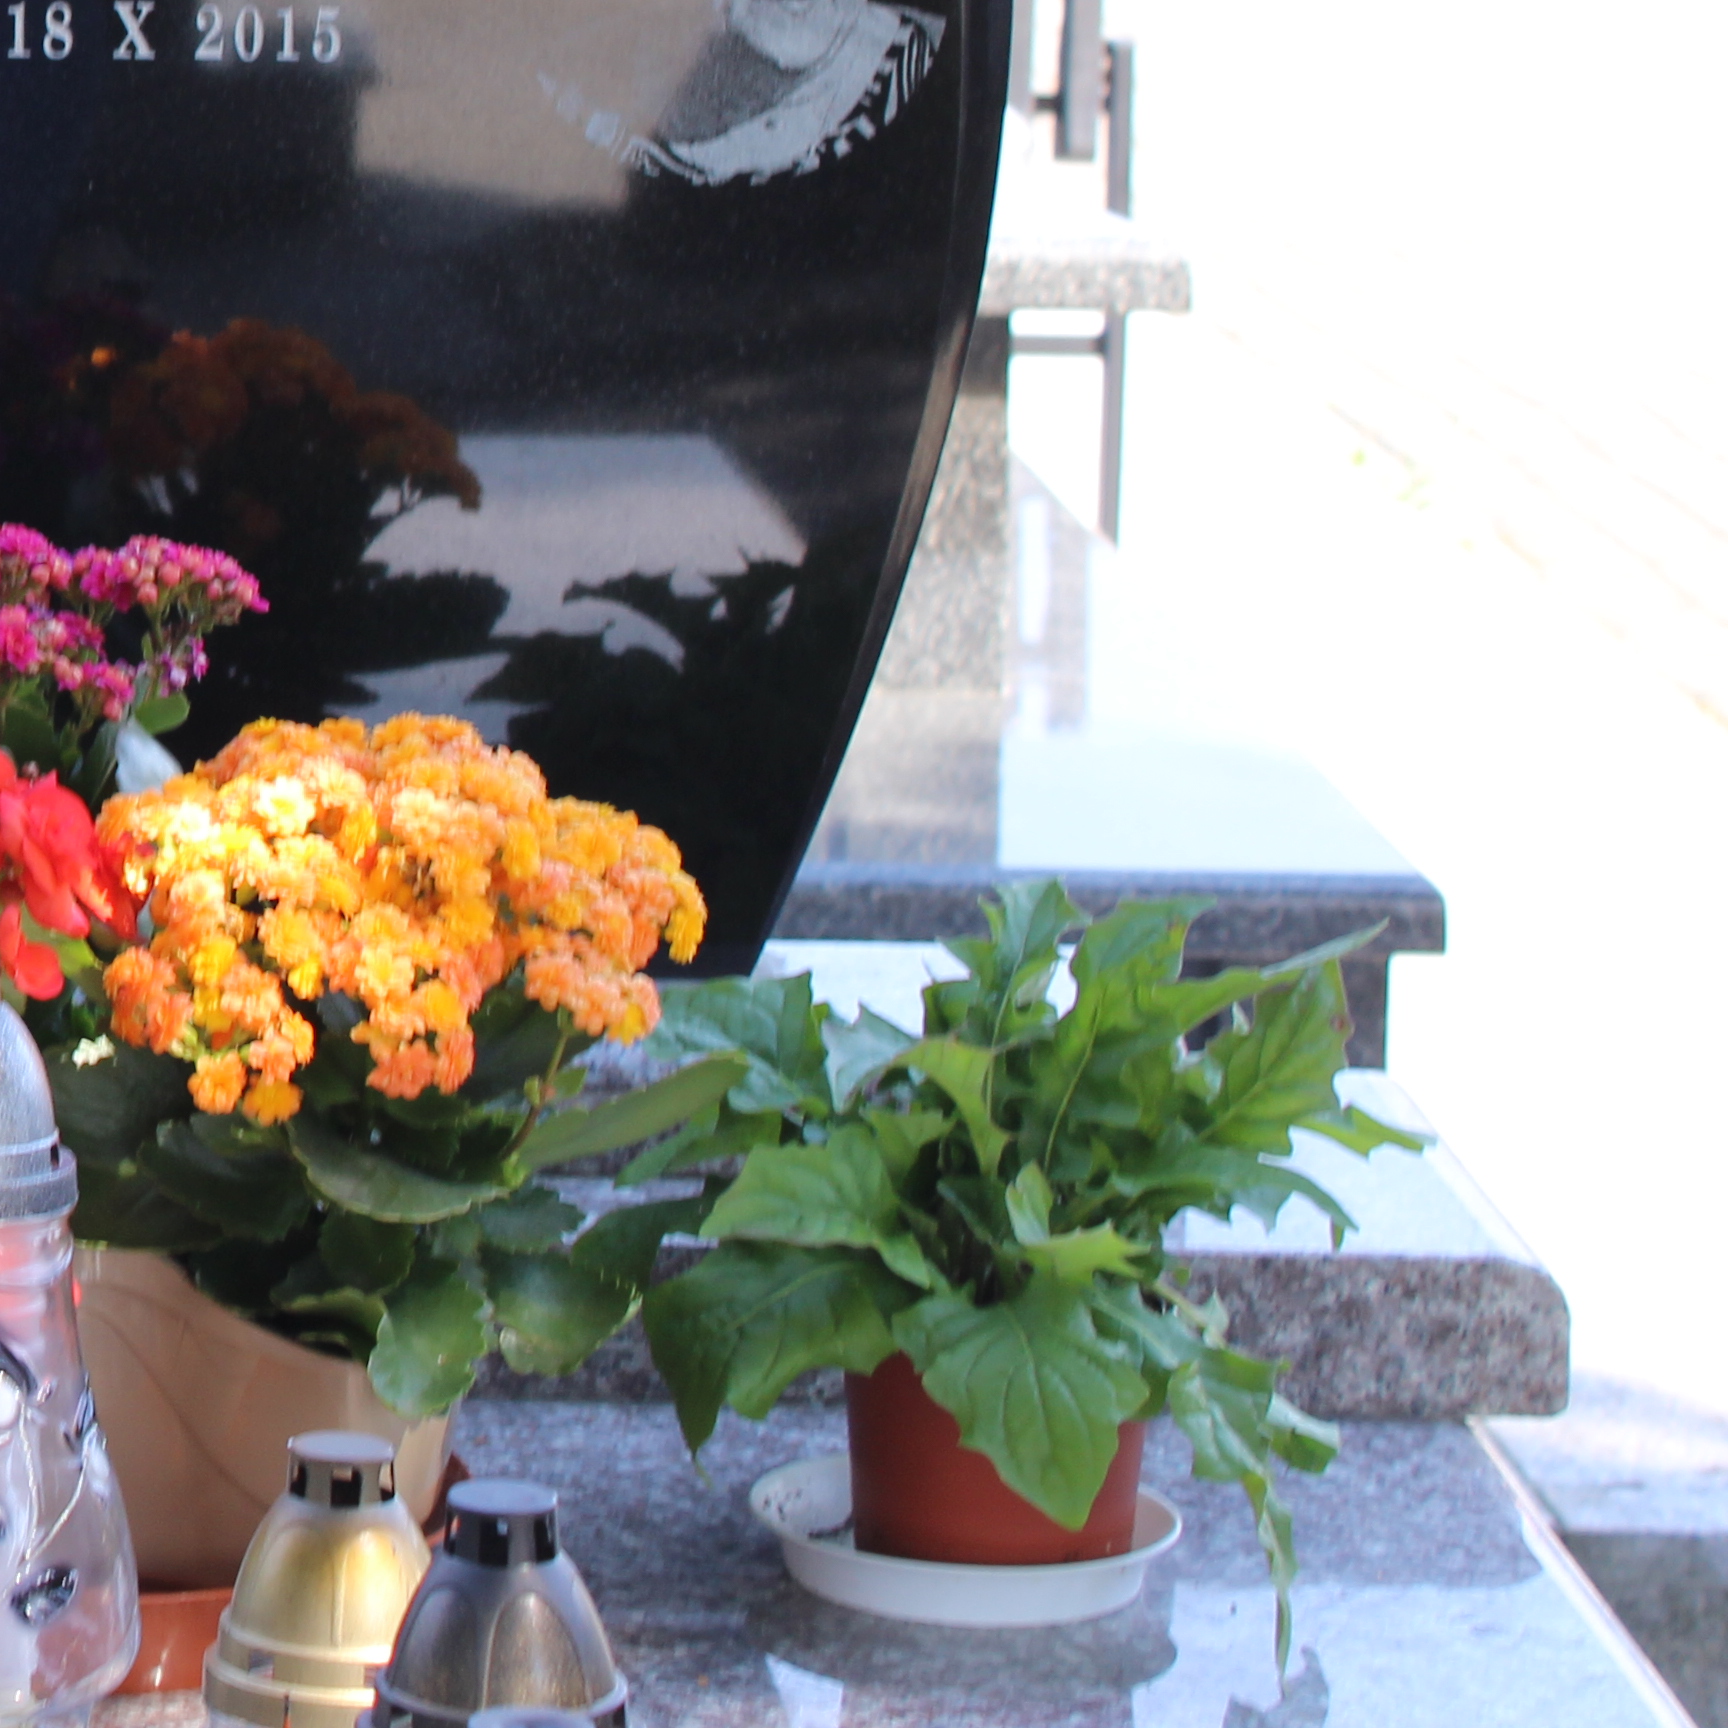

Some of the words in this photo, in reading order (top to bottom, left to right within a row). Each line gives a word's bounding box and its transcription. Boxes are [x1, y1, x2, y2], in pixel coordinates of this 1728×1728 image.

[6, 1, 73, 60] 18
[112, 1, 157, 62] X
[194, 3, 342, 64] 2015
